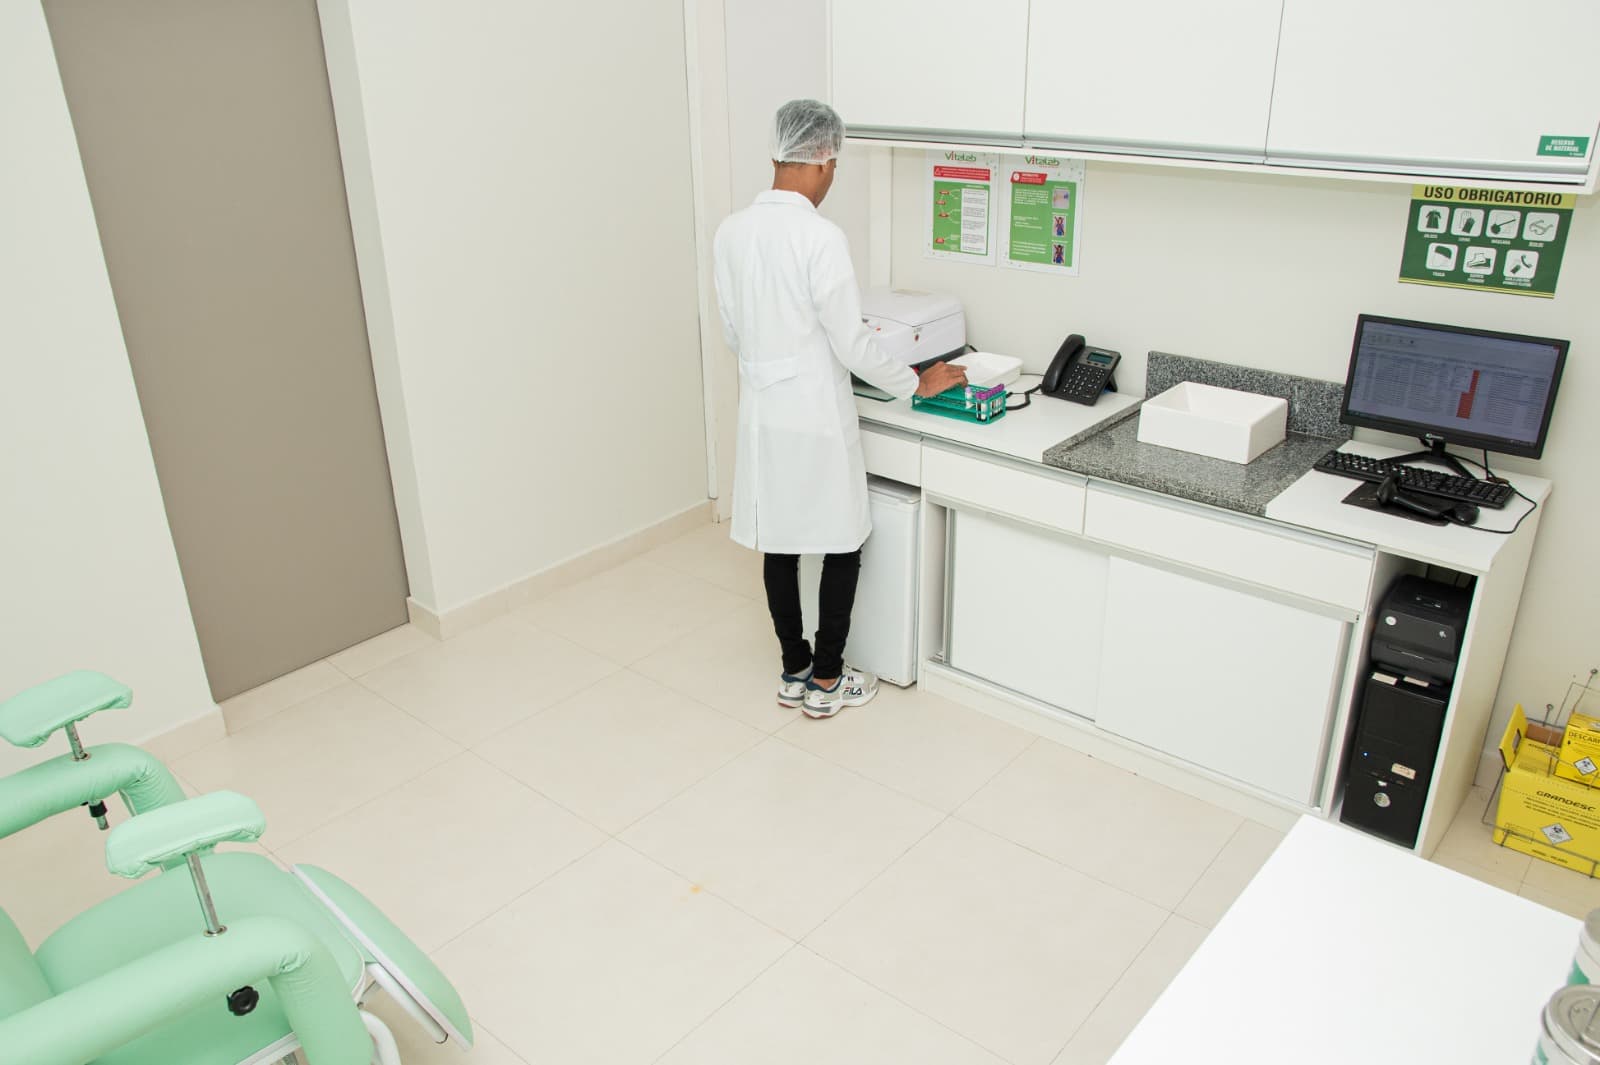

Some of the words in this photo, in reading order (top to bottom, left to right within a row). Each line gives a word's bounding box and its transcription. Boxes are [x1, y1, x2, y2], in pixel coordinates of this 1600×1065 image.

[1424, 186, 1454, 199] USO
[1458, 188, 1562, 206] OBRIGATORIO
[843, 687, 862, 696] FILA
